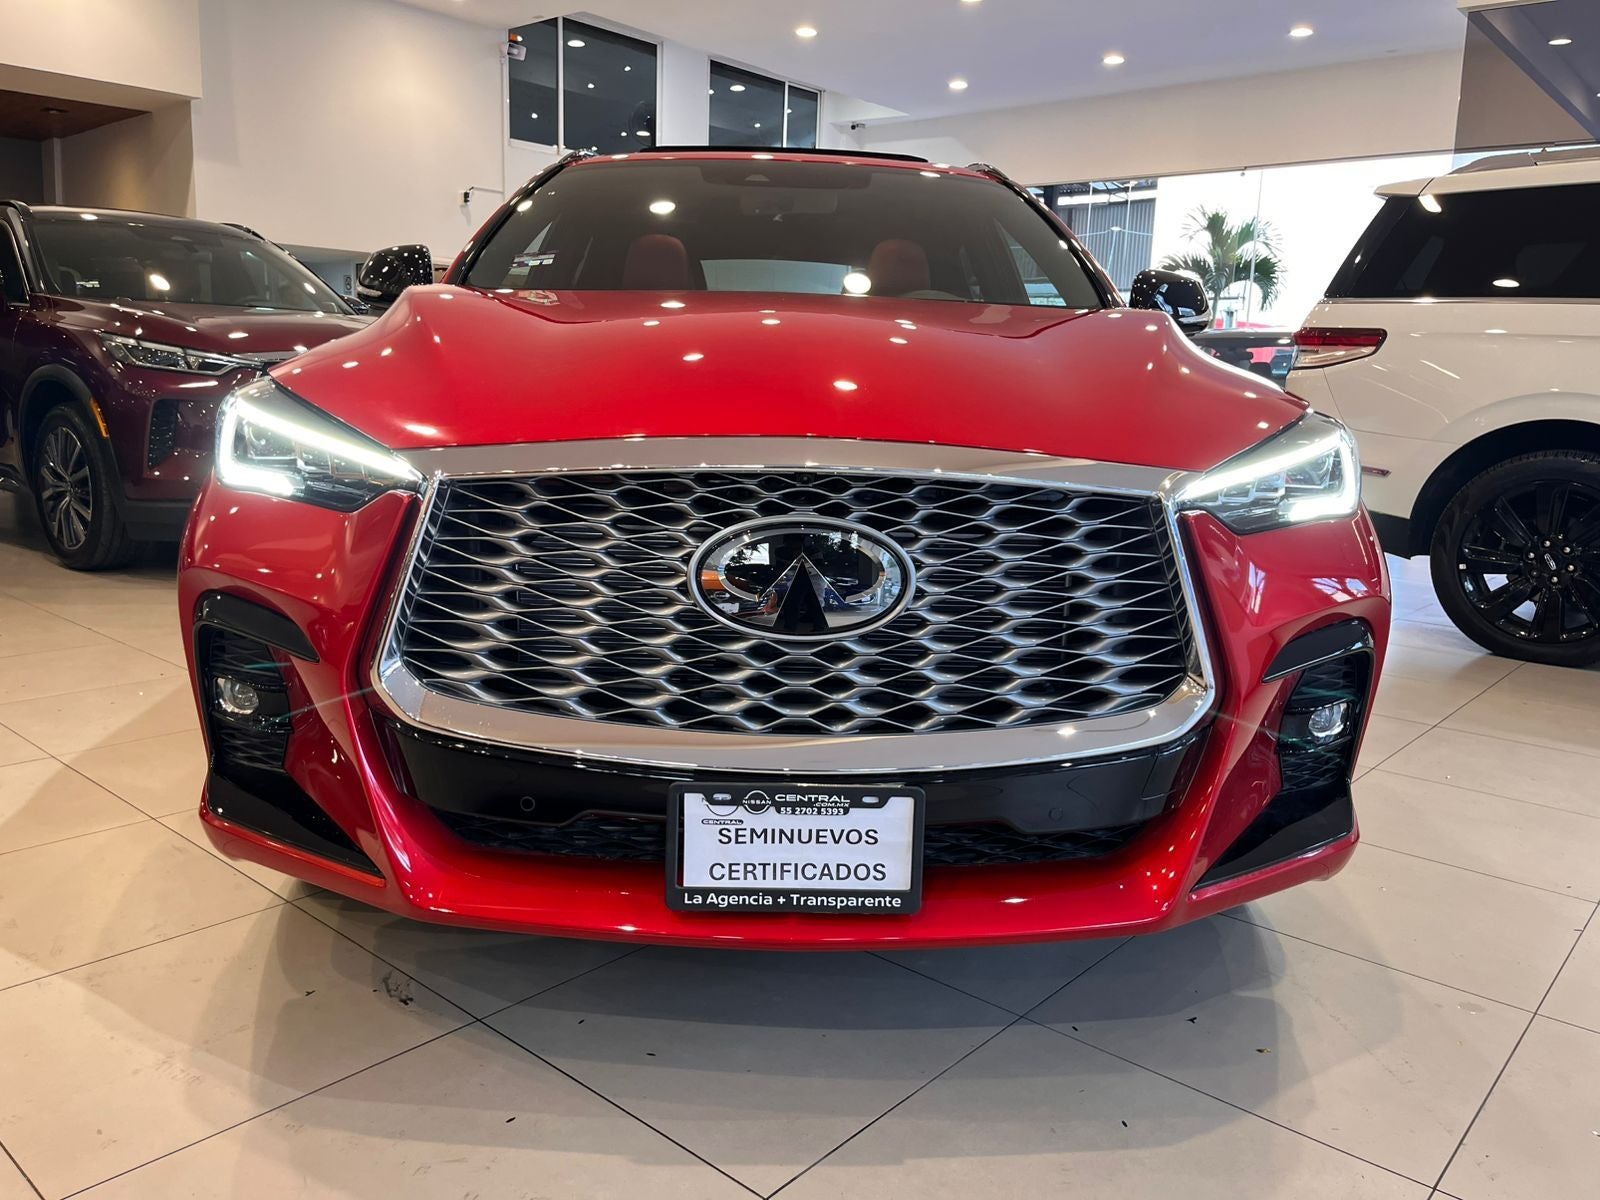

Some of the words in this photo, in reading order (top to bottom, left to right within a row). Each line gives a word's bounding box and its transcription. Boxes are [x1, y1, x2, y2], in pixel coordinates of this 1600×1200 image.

[774, 794, 851, 802] CENTRAL
[795, 807, 818, 815] 2702
[718, 827, 879, 845] SEMINUEVOS
[708, 862, 887, 881] CERTIFICADOS
[684, 892, 703, 905] La
[706, 893, 773, 906] Agencia
[790, 894, 901, 909] Transparente
